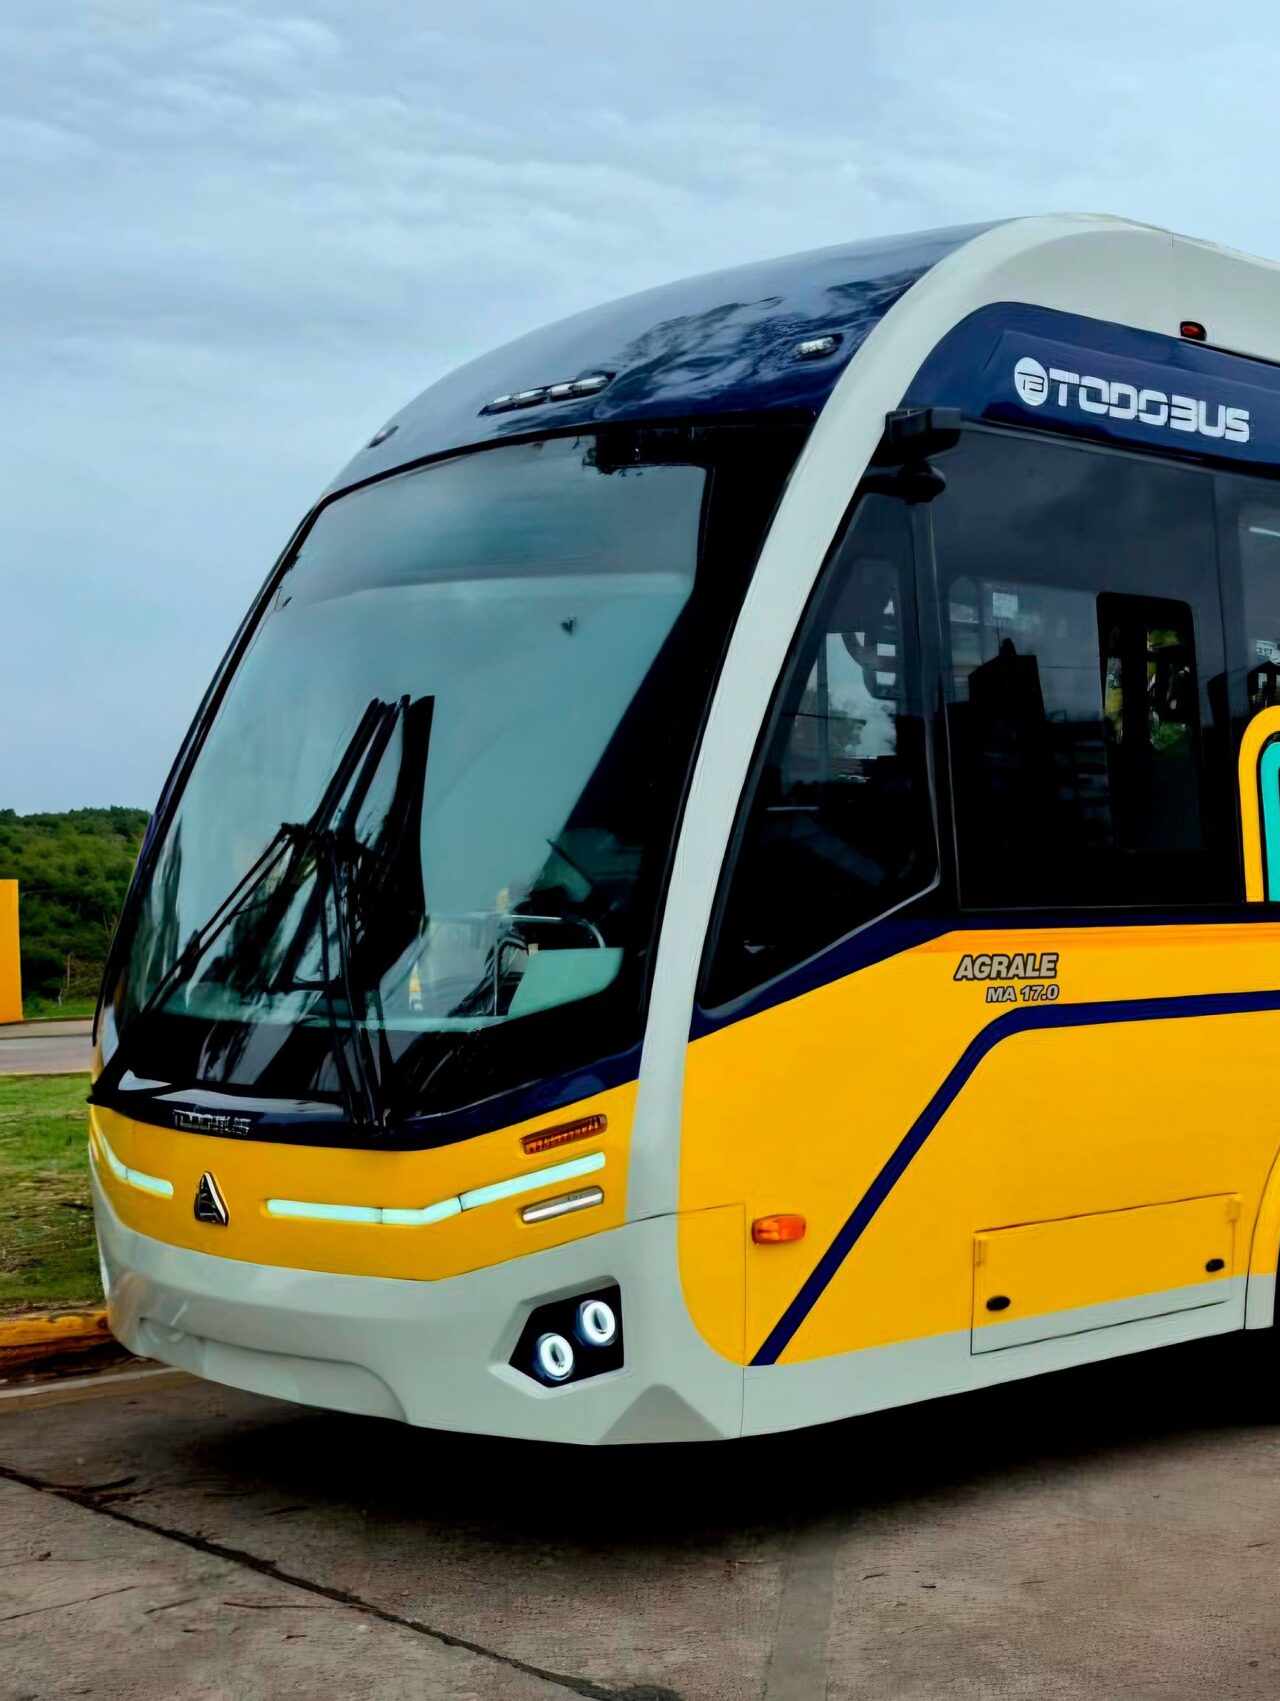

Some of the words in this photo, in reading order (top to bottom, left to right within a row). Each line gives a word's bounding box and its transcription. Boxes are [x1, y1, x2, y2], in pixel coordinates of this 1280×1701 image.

[953, 952, 1059, 981] AGRALE
[985, 986, 1017, 1003] MA
[1019, 983, 1060, 1003] 17.0
